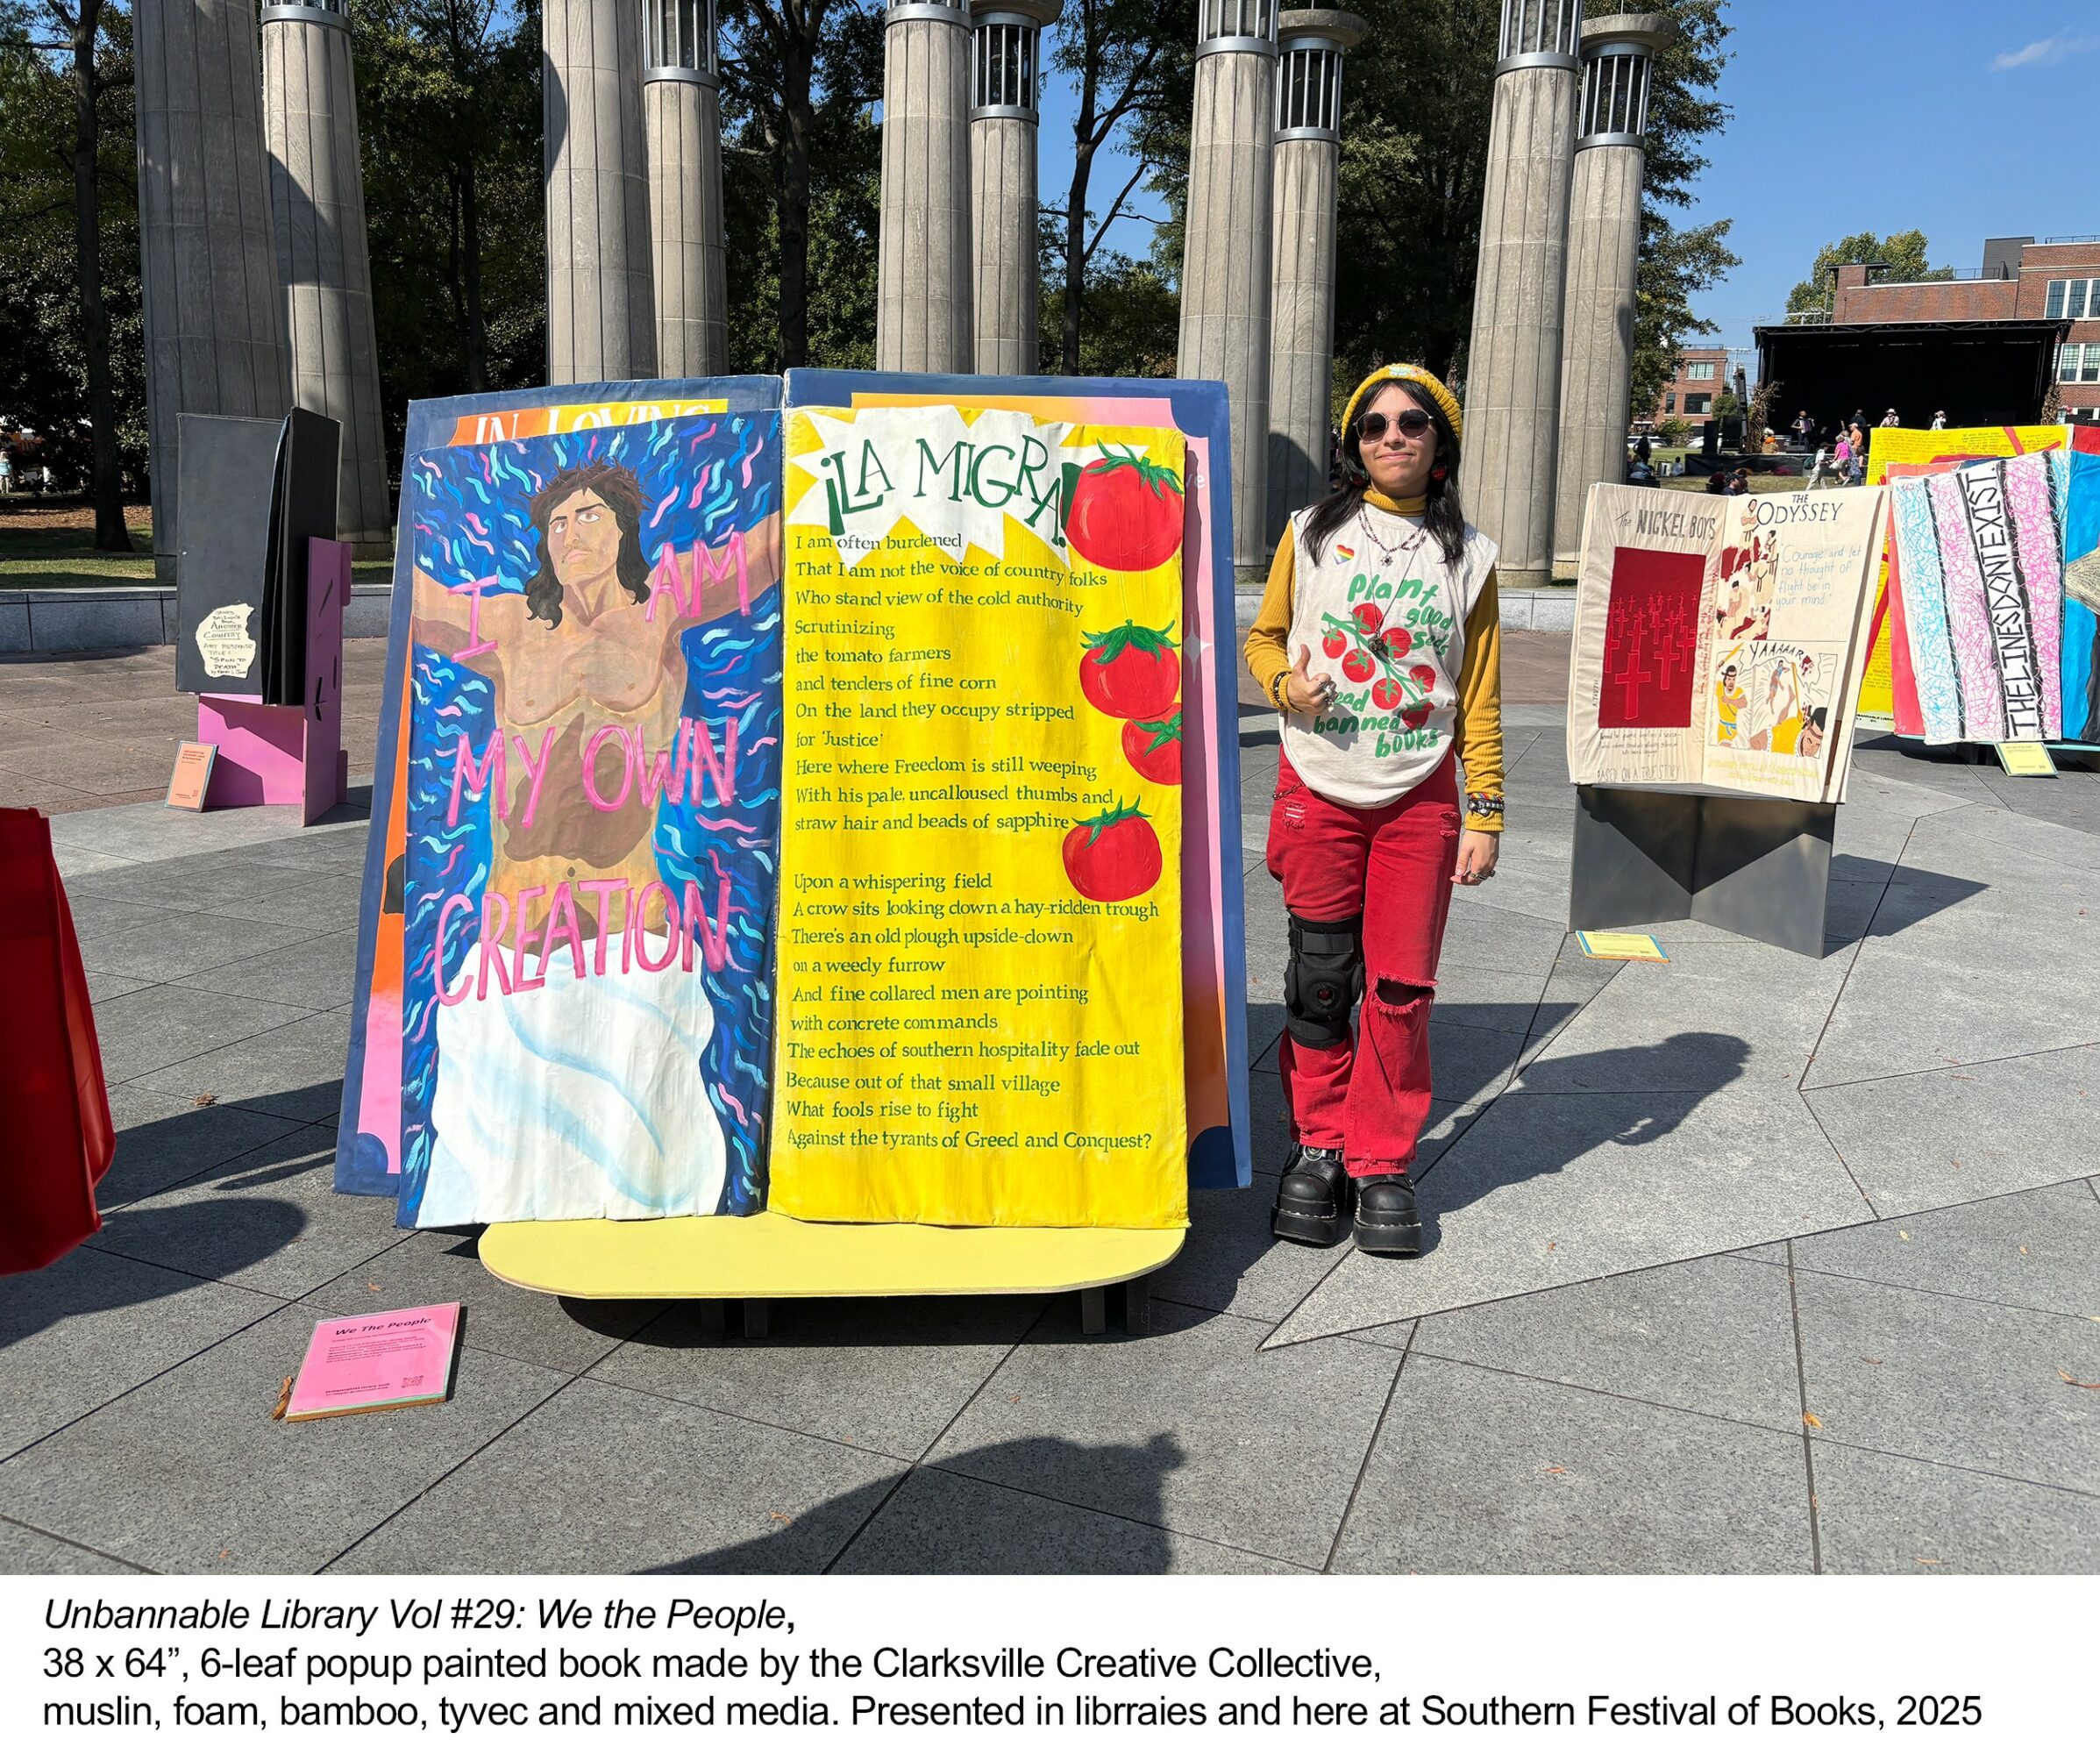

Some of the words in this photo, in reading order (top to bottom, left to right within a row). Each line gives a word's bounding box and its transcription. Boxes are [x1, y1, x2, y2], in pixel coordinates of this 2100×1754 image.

[476, 413, 519, 445] IN
[1792, 494, 1808, 503] THE
[1757, 502, 1843, 525] ODYSSEY
[1636, 510, 1684, 538] NICKEL
[1690, 516, 1716, 540] BOYS
[796, 537, 801, 548] I
[807, 538, 832, 548] am
[836, 535, 880, 550] often
[886, 533, 962, 549] burdened
[1829, 548, 1844, 558] and
[1850, 545, 1862, 557] let
[794, 562, 832, 575] That
[837, 562, 844, 576] I
[848, 567, 875, 577] am
[879, 565, 905, 578] not
[910, 561, 934, 575] the
[939, 562, 979, 576] voice
[984, 562, 1000, 576] of
[1004, 567, 1064, 586] country
[1069, 572, 1107, 586] folks
[1799, 562, 1835, 580] thought
[1840, 561, 1852, 574] of
[448, 574, 498, 663] I
[646, 531, 751, 623] AM
[1778, 580, 1803, 595] flight
[796, 590, 830, 604] Who
[836, 591, 881, 606] stand
[886, 594, 922, 605] view
[926, 588, 943, 602] of
[949, 589, 973, 604] the
[978, 591, 1010, 605] cold
[1016, 593, 1083, 617] authority
[1776, 596, 1797, 610] your
[794, 620, 894, 639] Scrutinizing
[1410, 631, 1449, 656] seds
[795, 648, 818, 663] the
[824, 650, 882, 663] tomato
[888, 648, 950, 662] farmers
[795, 675, 824, 691] and
[829, 675, 893, 690] tenders
[896, 674, 913, 689] of
[919, 673, 953, 688] fine
[958, 680, 996, 689] corn
[1333, 688, 1370, 712] ead
[795, 703, 817, 717] On
[824, 702, 851, 717] the
[859, 703, 897, 718] land
[901, 702, 936, 718] they
[940, 705, 1000, 722] occupy
[1006, 702, 1074, 722] stripped
[795, 732, 815, 747] for
[1375, 724, 1439, 759] books
[447, 726, 556, 828] MY
[582, 717, 737, 811] OWN
[795, 759, 832, 775] Here
[836, 759, 889, 774] where
[893, 756, 965, 774] Freedom
[972, 759, 985, 773] is
[991, 757, 1023, 772] still
[1029, 760, 1097, 781] weeping
[794, 873, 833, 893] Upon
[838, 878, 849, 888] a
[852, 873, 946, 894] whispering
[953, 873, 992, 888] field
[434, 878, 730, 1007] CREATION
[787, 1130, 845, 1149] Against
[849, 1129, 878, 1145] the
[881, 1131, 938, 1150] tyrants
[941, 1130, 960, 1147] of
[965, 1131, 1018, 1147] Greed
[1024, 1131, 1058, 1147] and
[1063, 1132, 1151, 1152] Conquest?
[335, 1328, 357, 1337] We
[361, 1324, 386, 1333] The
[388, 1317, 432, 1330] People
